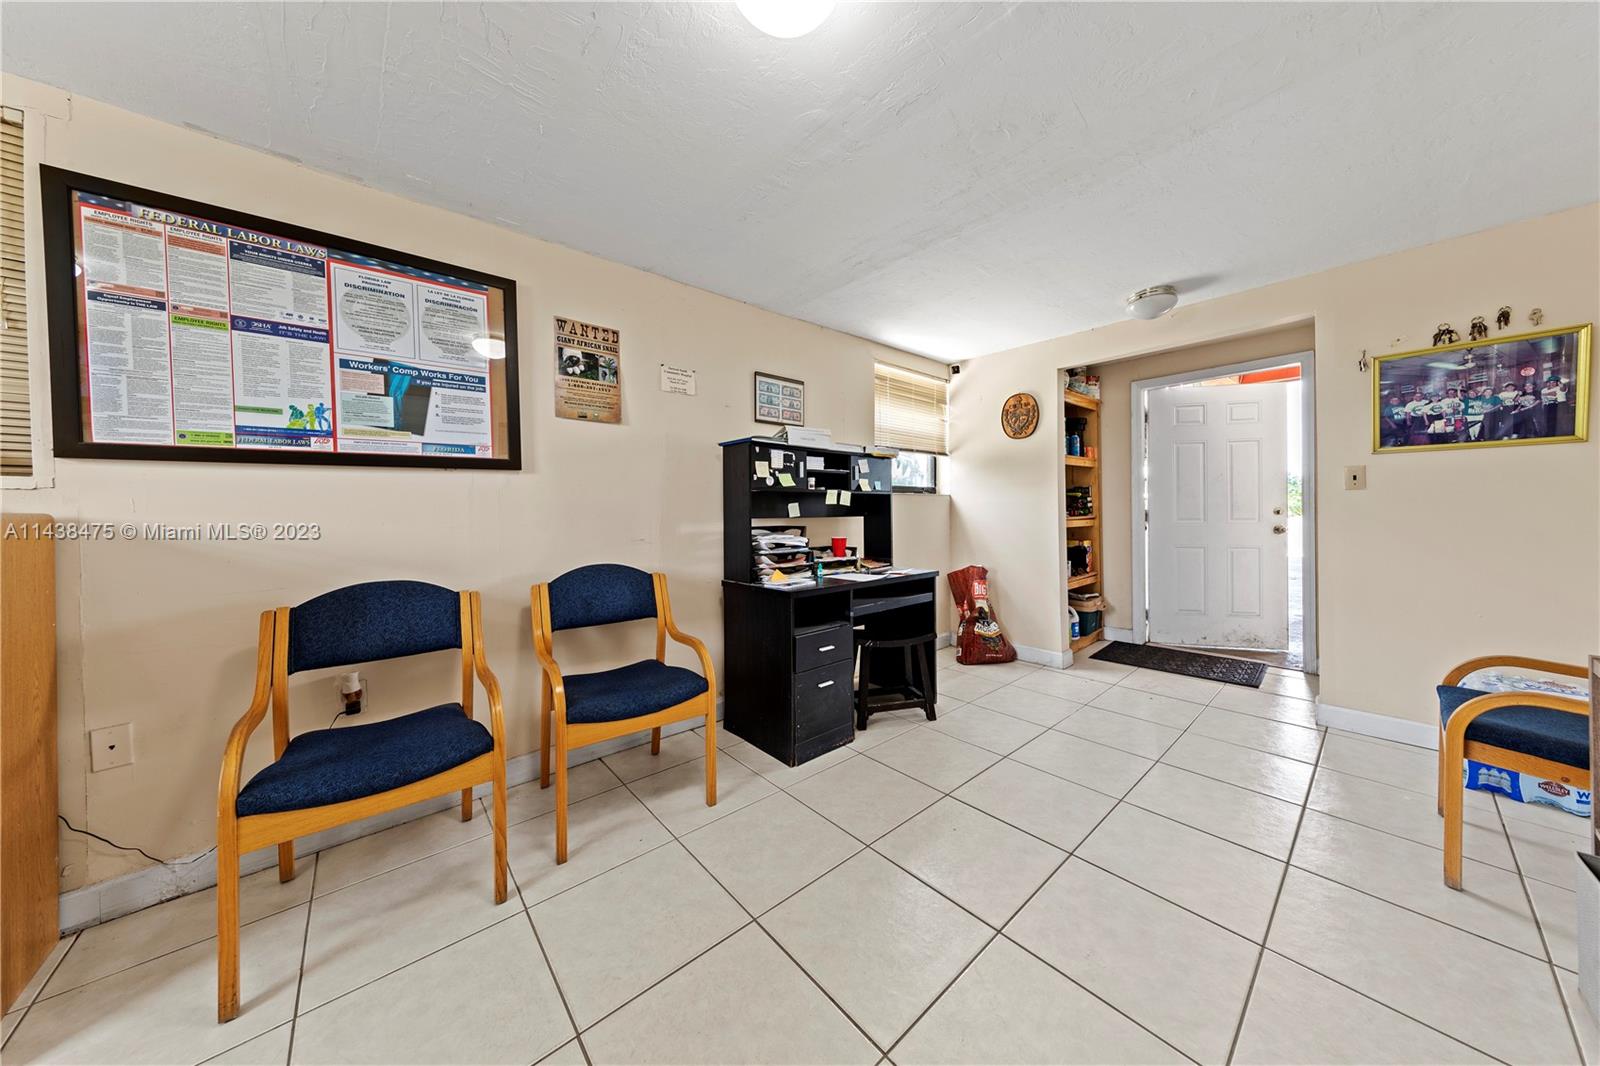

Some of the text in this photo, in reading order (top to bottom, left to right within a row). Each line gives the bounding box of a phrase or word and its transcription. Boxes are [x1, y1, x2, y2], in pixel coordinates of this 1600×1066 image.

[93, 210, 128, 221] EMPLOYEE
[130, 218, 153, 227] RIGHTS
[139, 208, 222, 235] FEDERAL
[226, 227, 282, 249] LABOR
[286, 242, 327, 258] LAWS
[344, 282, 406, 298] DISCRIMINATION
[556, 318, 619, 344] WANTED
[556, 336, 618, 354] GIANT AFRICAN SNAIL
[348, 360, 479, 383] Workers' Comp Works For You
[974, 582, 987, 596] BIG
